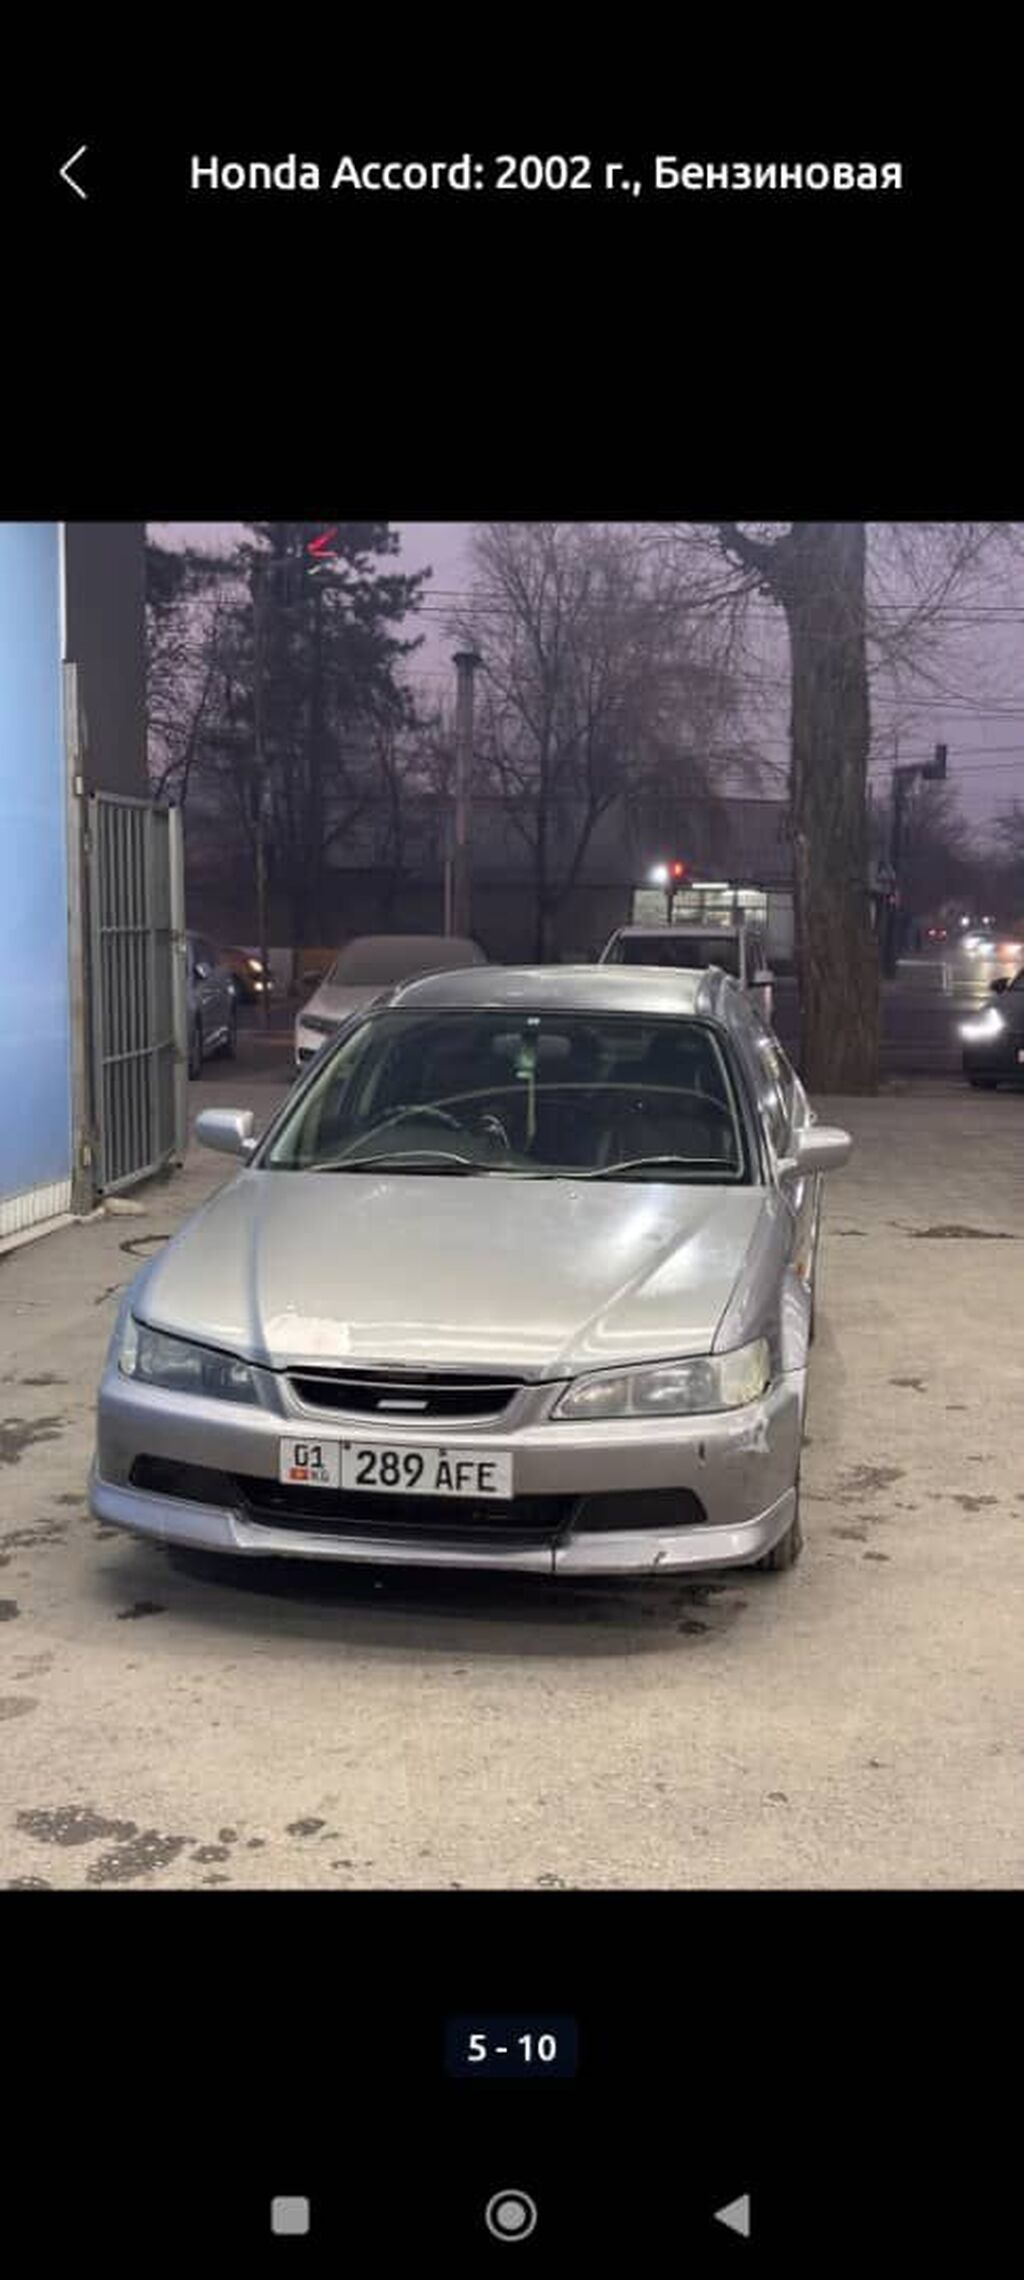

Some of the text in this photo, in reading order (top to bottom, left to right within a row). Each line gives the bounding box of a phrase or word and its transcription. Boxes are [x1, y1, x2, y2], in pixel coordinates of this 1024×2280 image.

[294, 1444, 323, 1467] 01
[355, 1450, 497, 1492] 289 AFE
